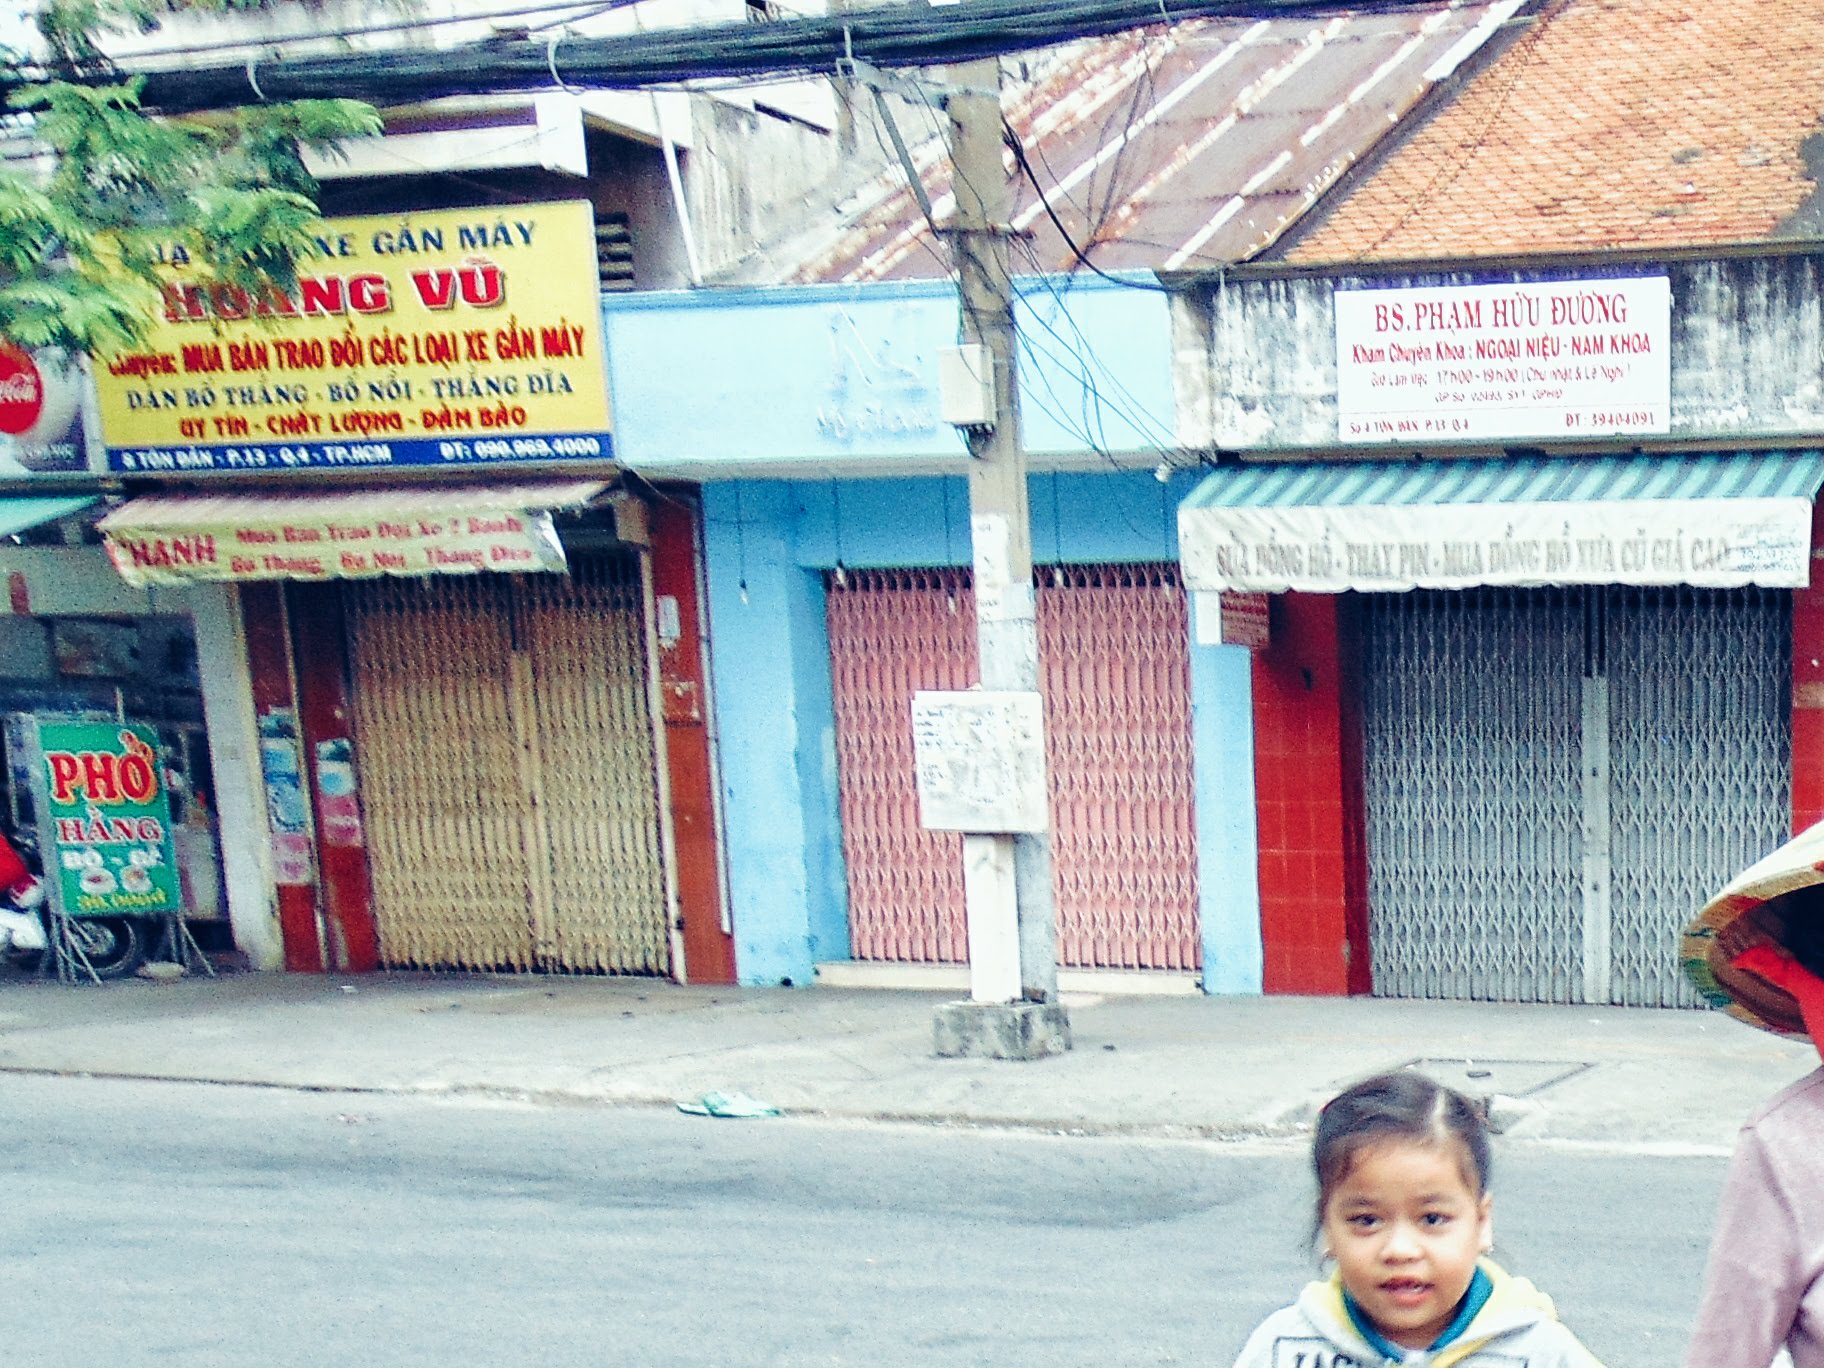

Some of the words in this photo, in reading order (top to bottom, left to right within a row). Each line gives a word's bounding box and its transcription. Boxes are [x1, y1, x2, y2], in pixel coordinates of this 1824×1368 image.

[457, 217, 536, 250] MÁY
[408, 253, 506, 311] VŨ
[181, 343, 225, 373] MUA
[228, 332, 269, 372] BÁN
[273, 338, 325, 370] TRAO
[370, 325, 408, 367] CÁC
[412, 330, 459, 369] LOẠI
[463, 328, 490, 363] XE
[541, 316, 585, 357] MÁY
[1571, 334, 1605, 356] NAM
[1610, 331, 1652, 354] KHOA
[179, 417, 205, 438] UY
[45, 728, 159, 807] PHỞ
